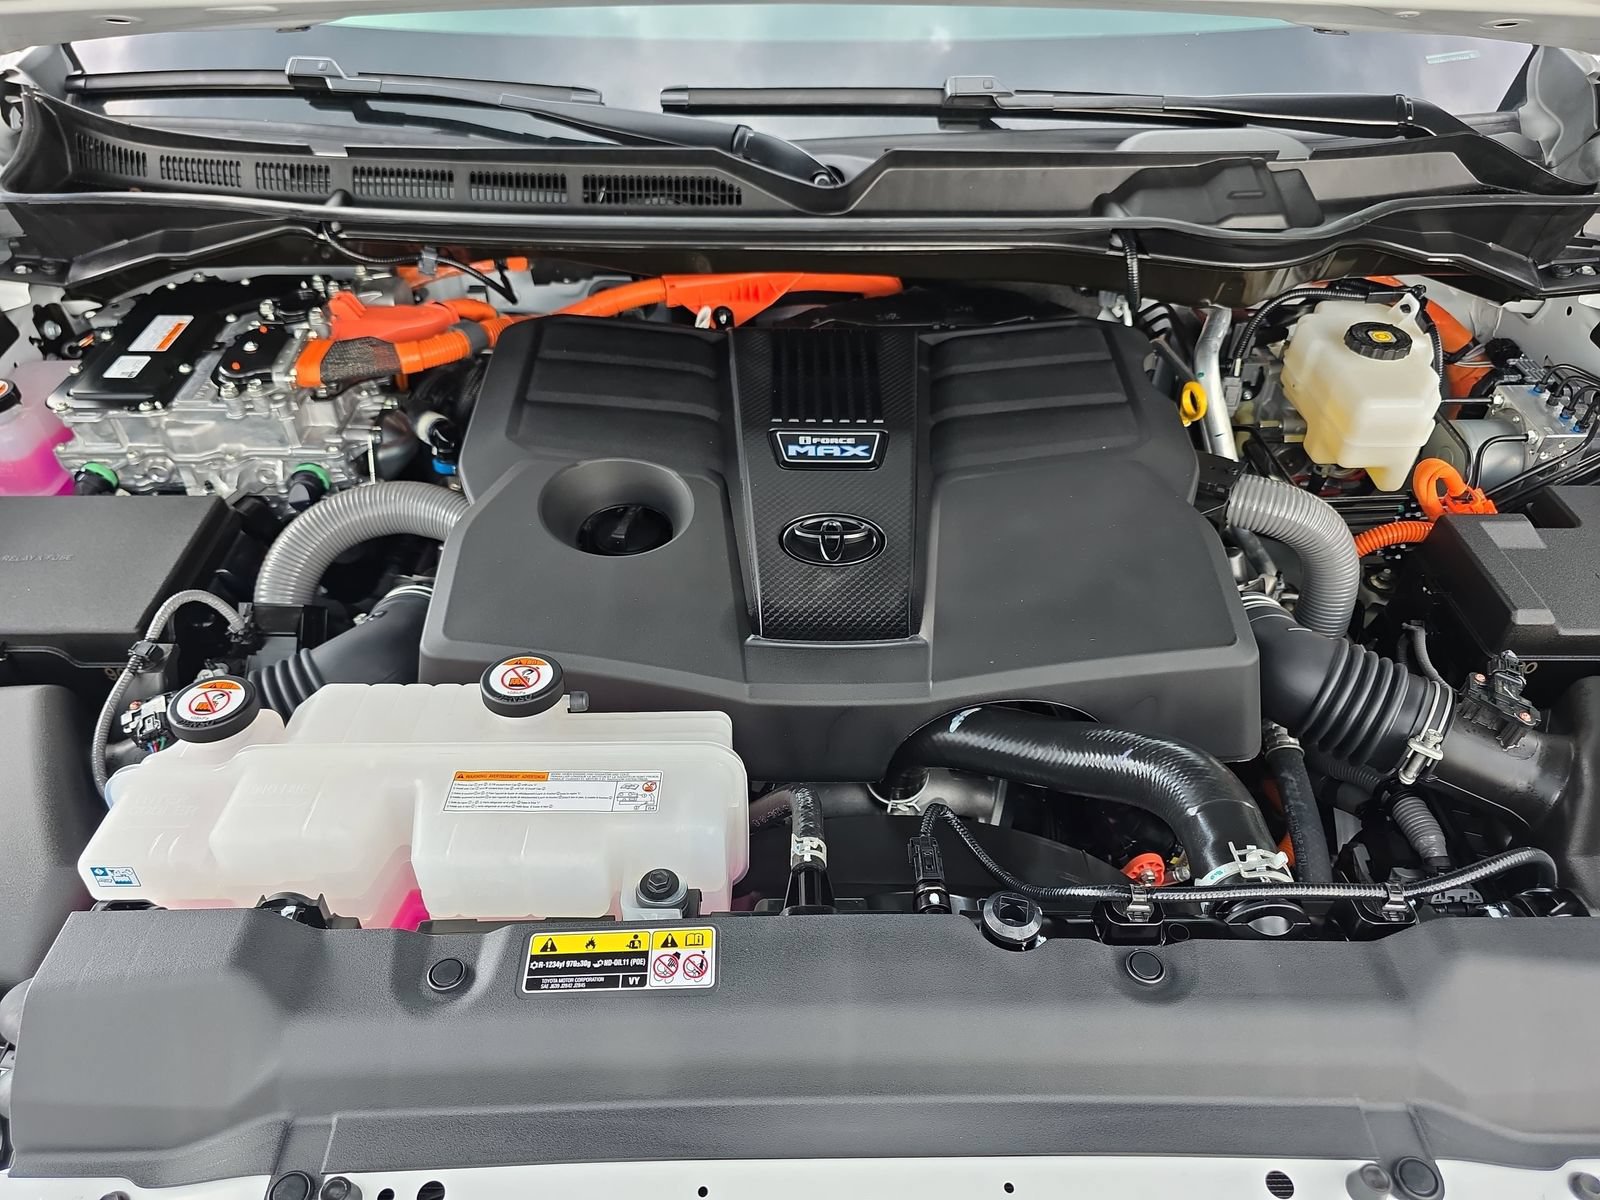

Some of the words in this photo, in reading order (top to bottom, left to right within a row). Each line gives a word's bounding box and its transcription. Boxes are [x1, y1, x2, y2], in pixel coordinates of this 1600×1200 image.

[787, 445, 870, 457] MAX
[538, 960, 566, 970] R-1234yf
[630, 957, 646, 967] (POE)
[628, 976, 641, 985] VY
